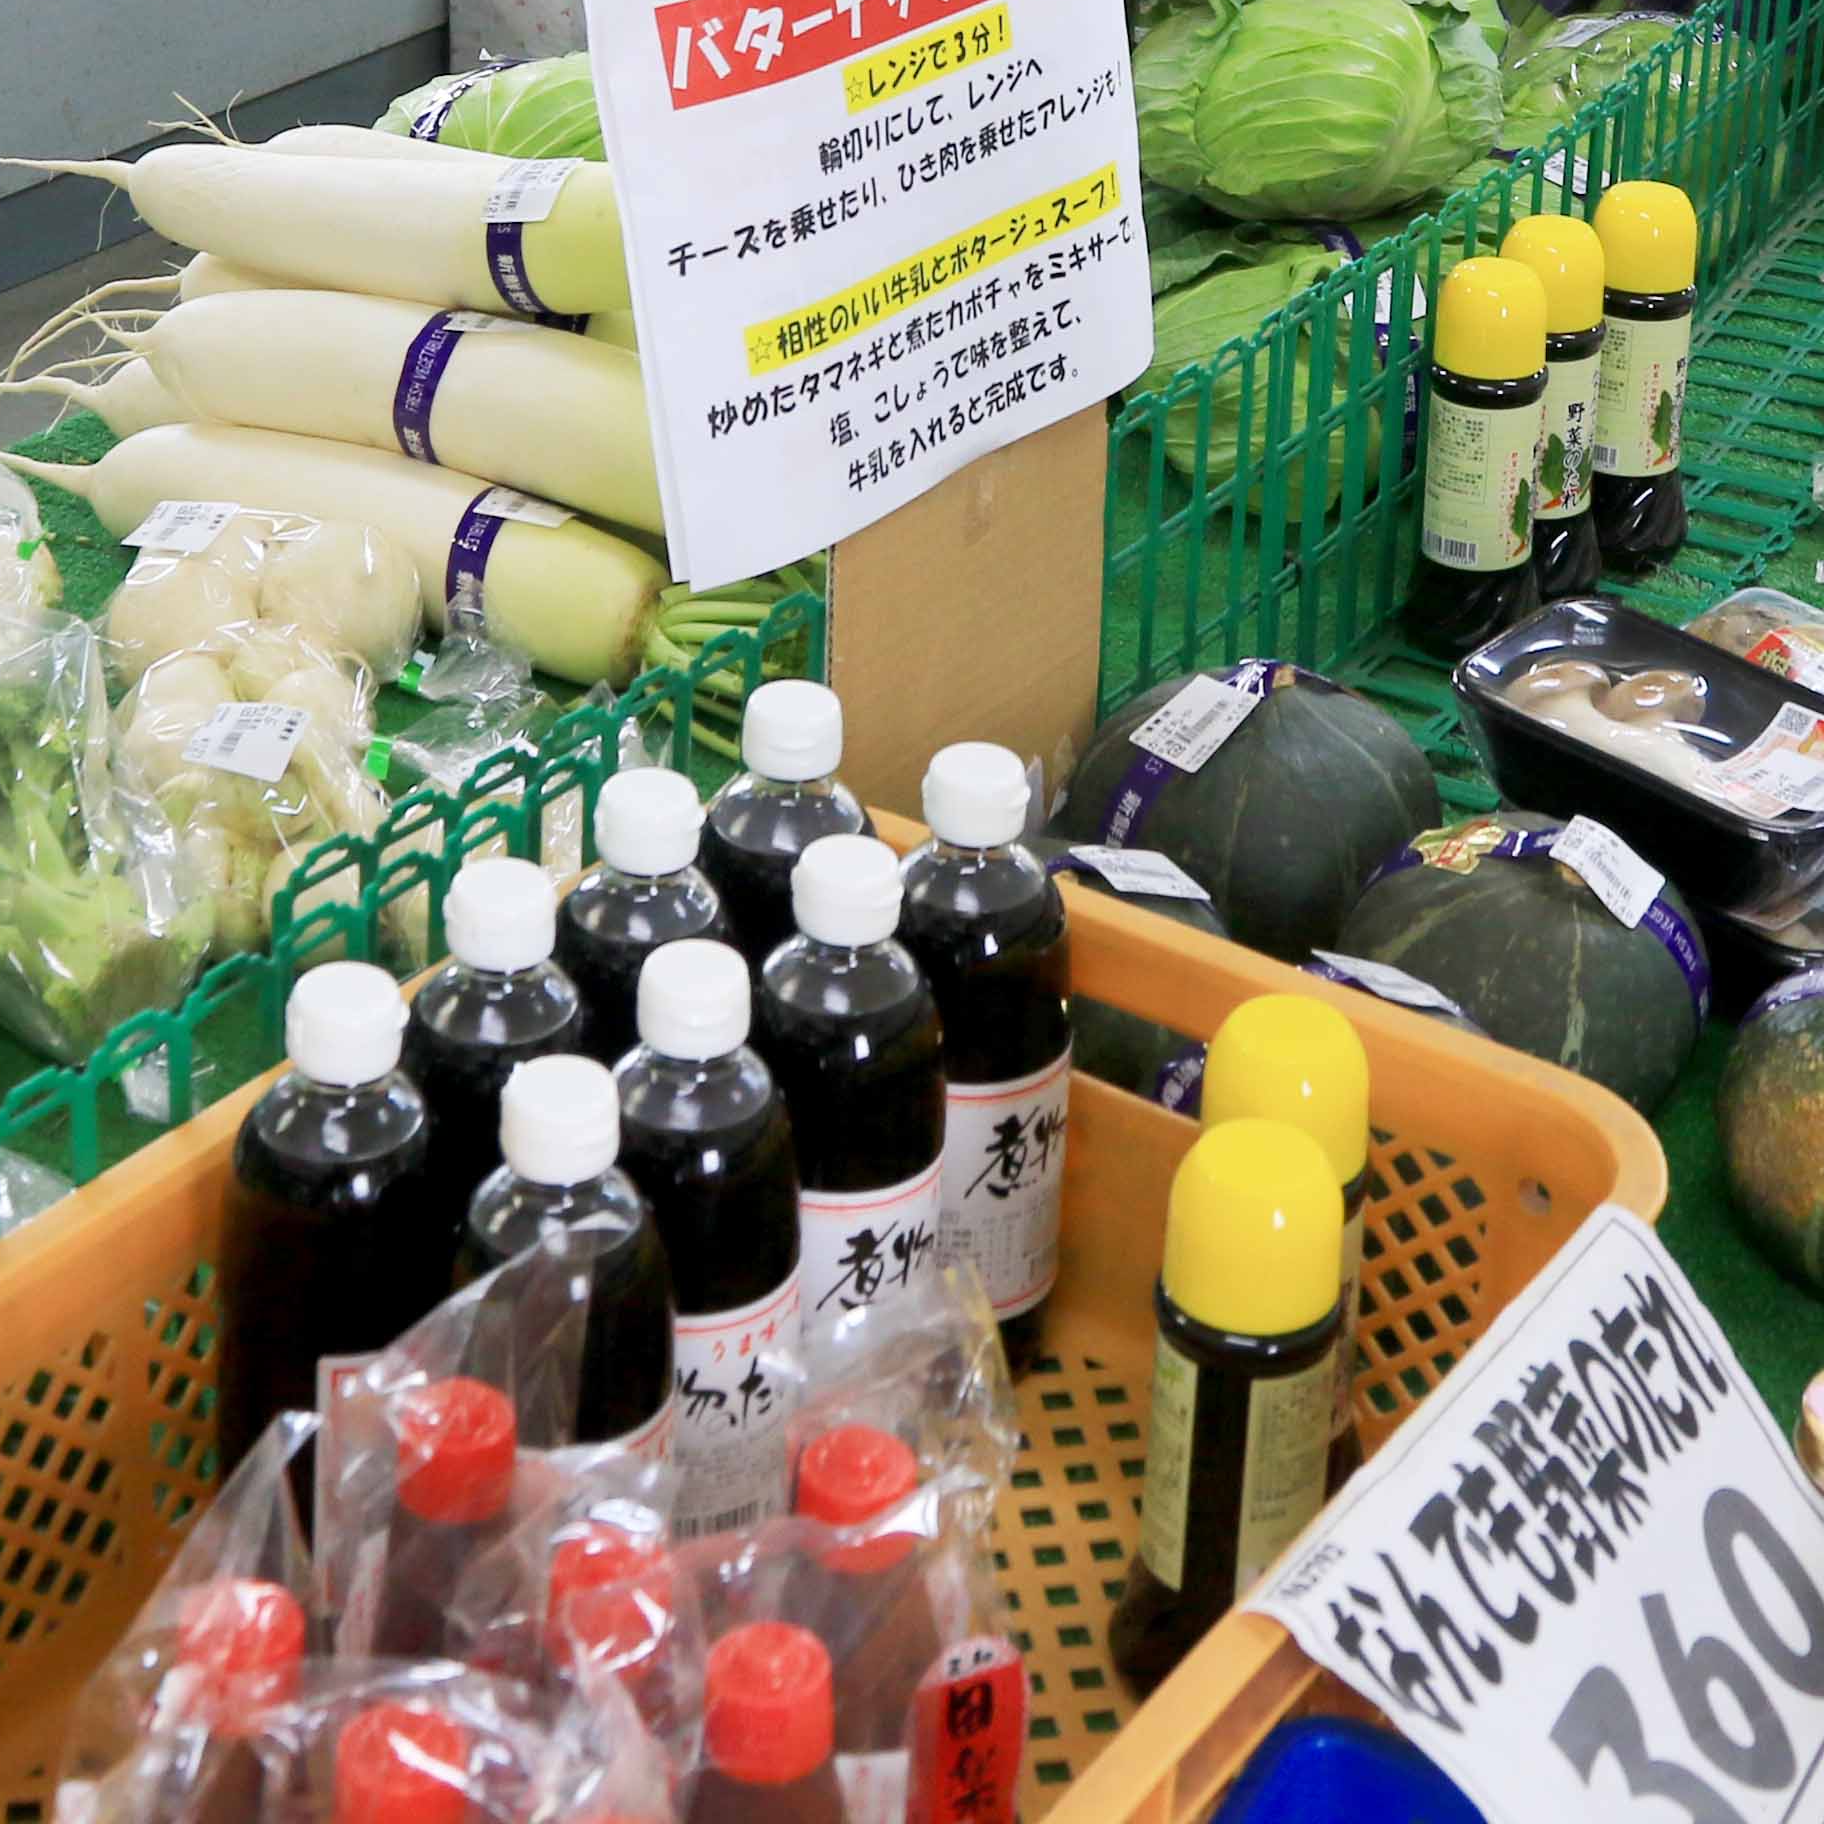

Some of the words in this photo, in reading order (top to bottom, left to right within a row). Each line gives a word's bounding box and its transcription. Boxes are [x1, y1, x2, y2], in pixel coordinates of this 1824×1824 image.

[816, 60, 1044, 174] 輪切りにして、レンジへ
[707, 215, 1136, 438] 炒めたタマネギと煮たカボチャをミキサーで
[828, 310, 1086, 448] 塩、こしょうで味を整えて、
[402, 382, 424, 414] FRESH
[847, 356, 1083, 490] 牛乳を入れると完成です。
[1562, 401, 1586, 511] 野菜のたれ
[1333, 1269, 1730, 1733] なんでも野菜のたれ
